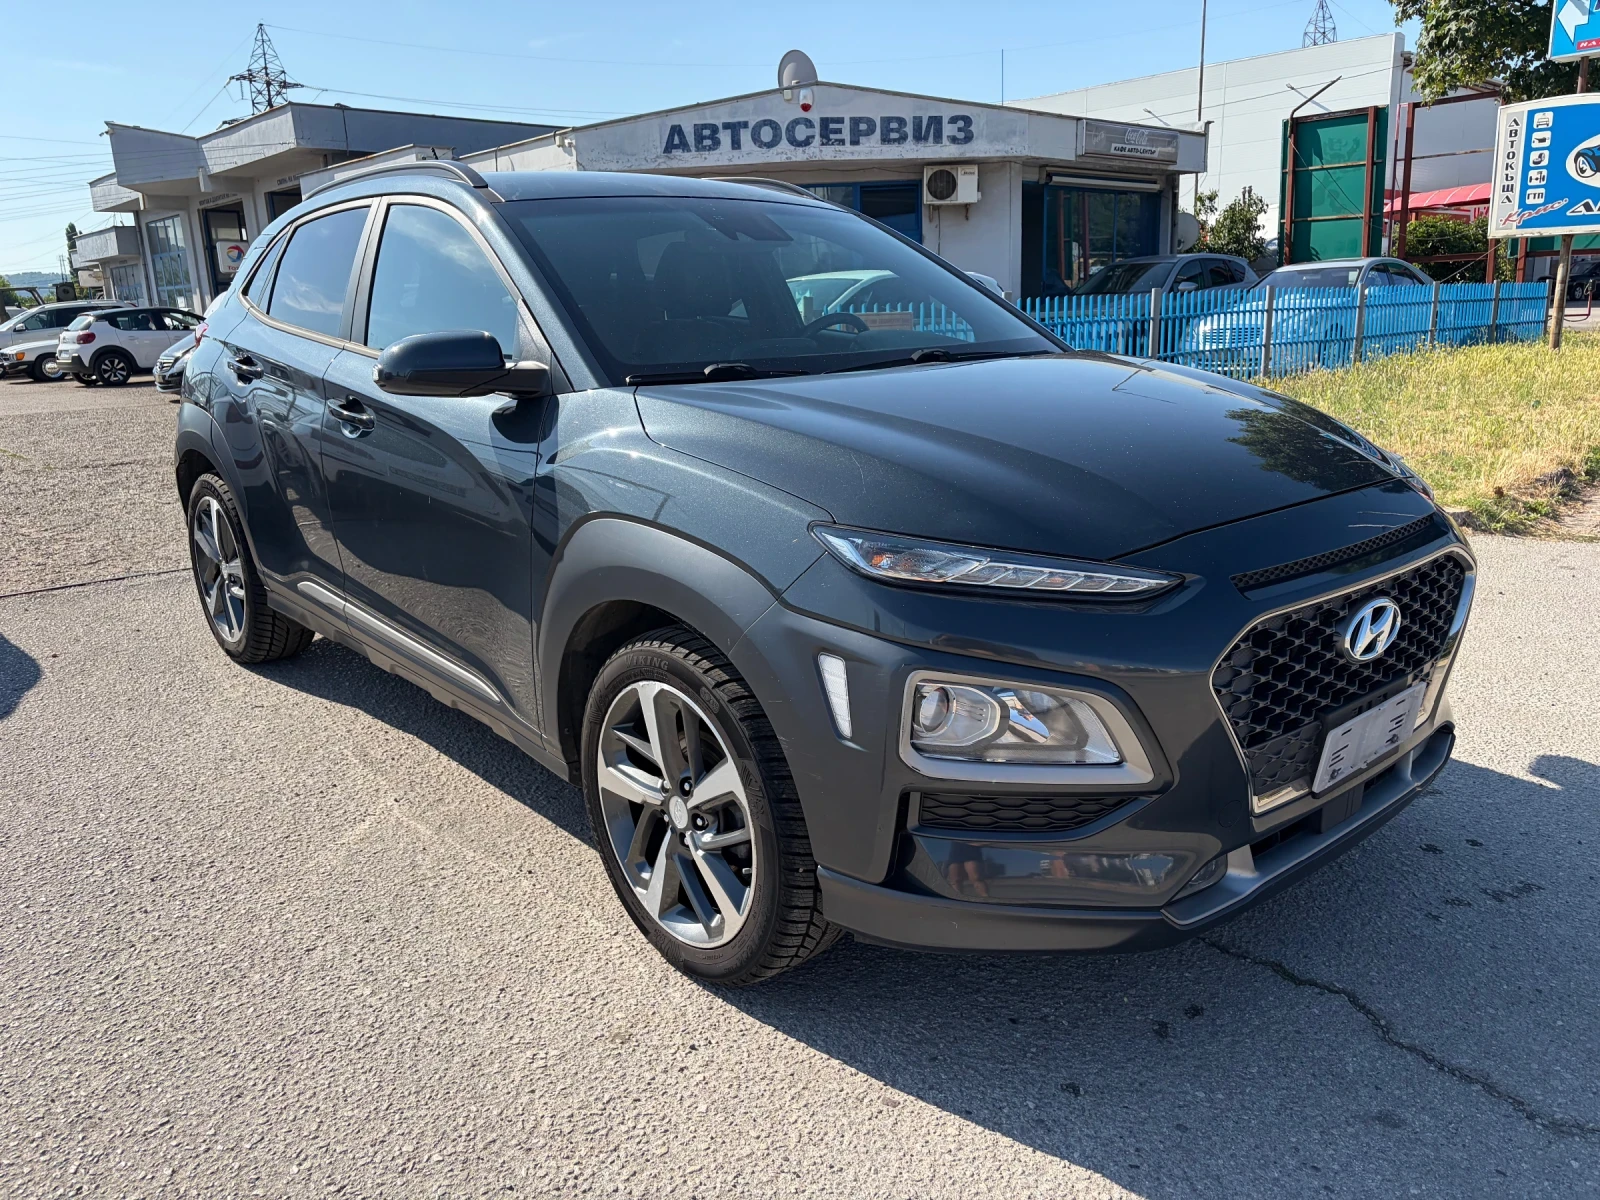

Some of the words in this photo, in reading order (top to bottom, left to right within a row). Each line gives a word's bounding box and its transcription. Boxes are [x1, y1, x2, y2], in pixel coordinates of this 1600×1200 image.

[663, 114, 974, 154] АВТОСЕРВИЗ
[1113, 145, 1127, 153] КАФЕ
[1501, 117, 1521, 204] АВТОКЪЩА
[1526, 191, 1544, 201] ГТП
[624, 653, 669, 671] VIKING
